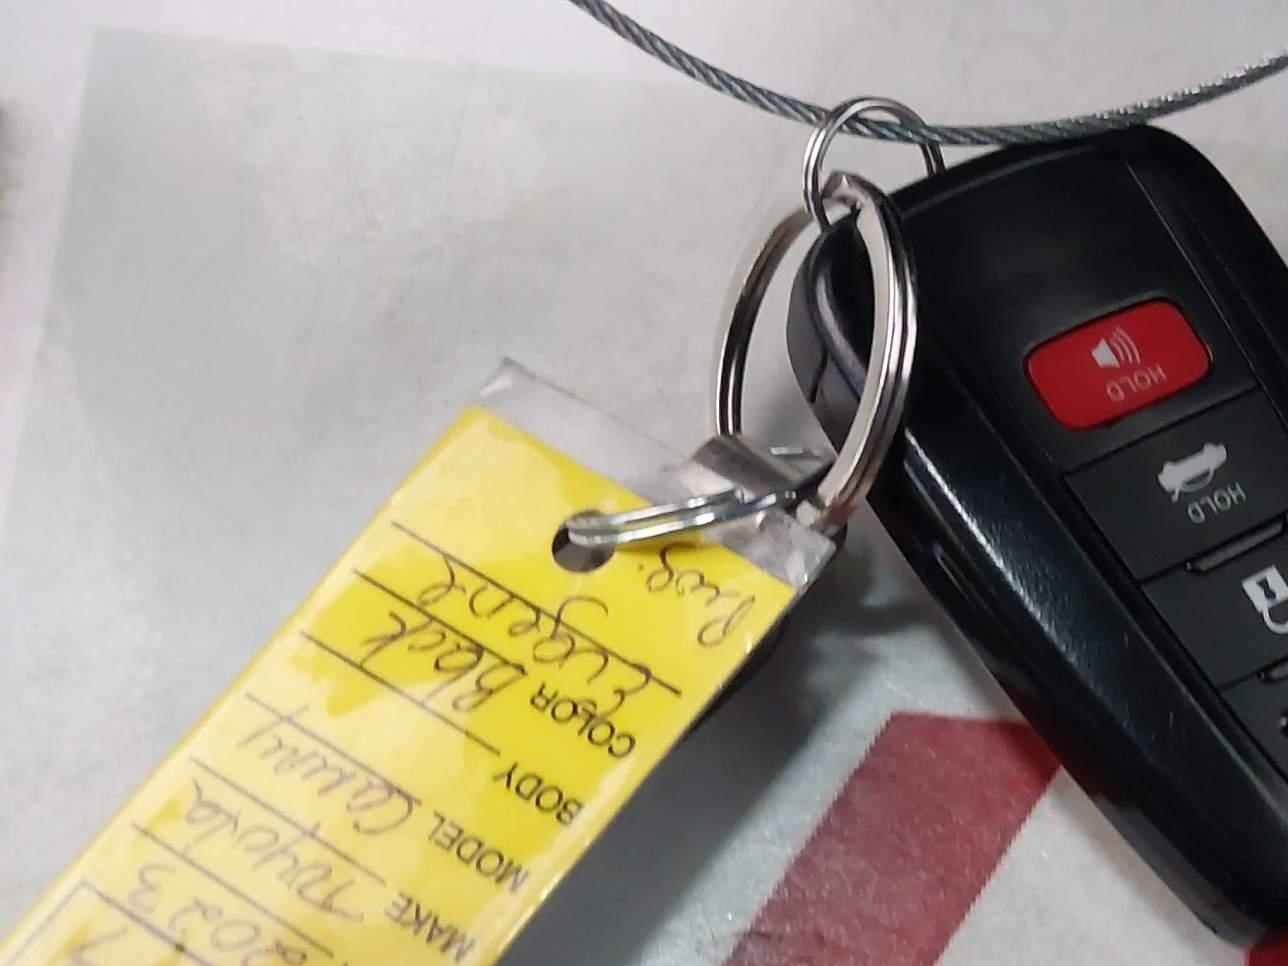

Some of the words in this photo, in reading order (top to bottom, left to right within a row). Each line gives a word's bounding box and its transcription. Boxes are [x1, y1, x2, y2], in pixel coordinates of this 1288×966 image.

[1106, 363, 1167, 401] HOLD
[1186, 481, 1247, 524] HOLD
[360, 610, 527, 713] Black
[529, 682, 637, 760] COLOR
[492, 761, 586, 827] BODY
[183, 776, 365, 923] Toyota
[426, 810, 530, 895] MODEL
[382, 890, 476, 966] MAKE
